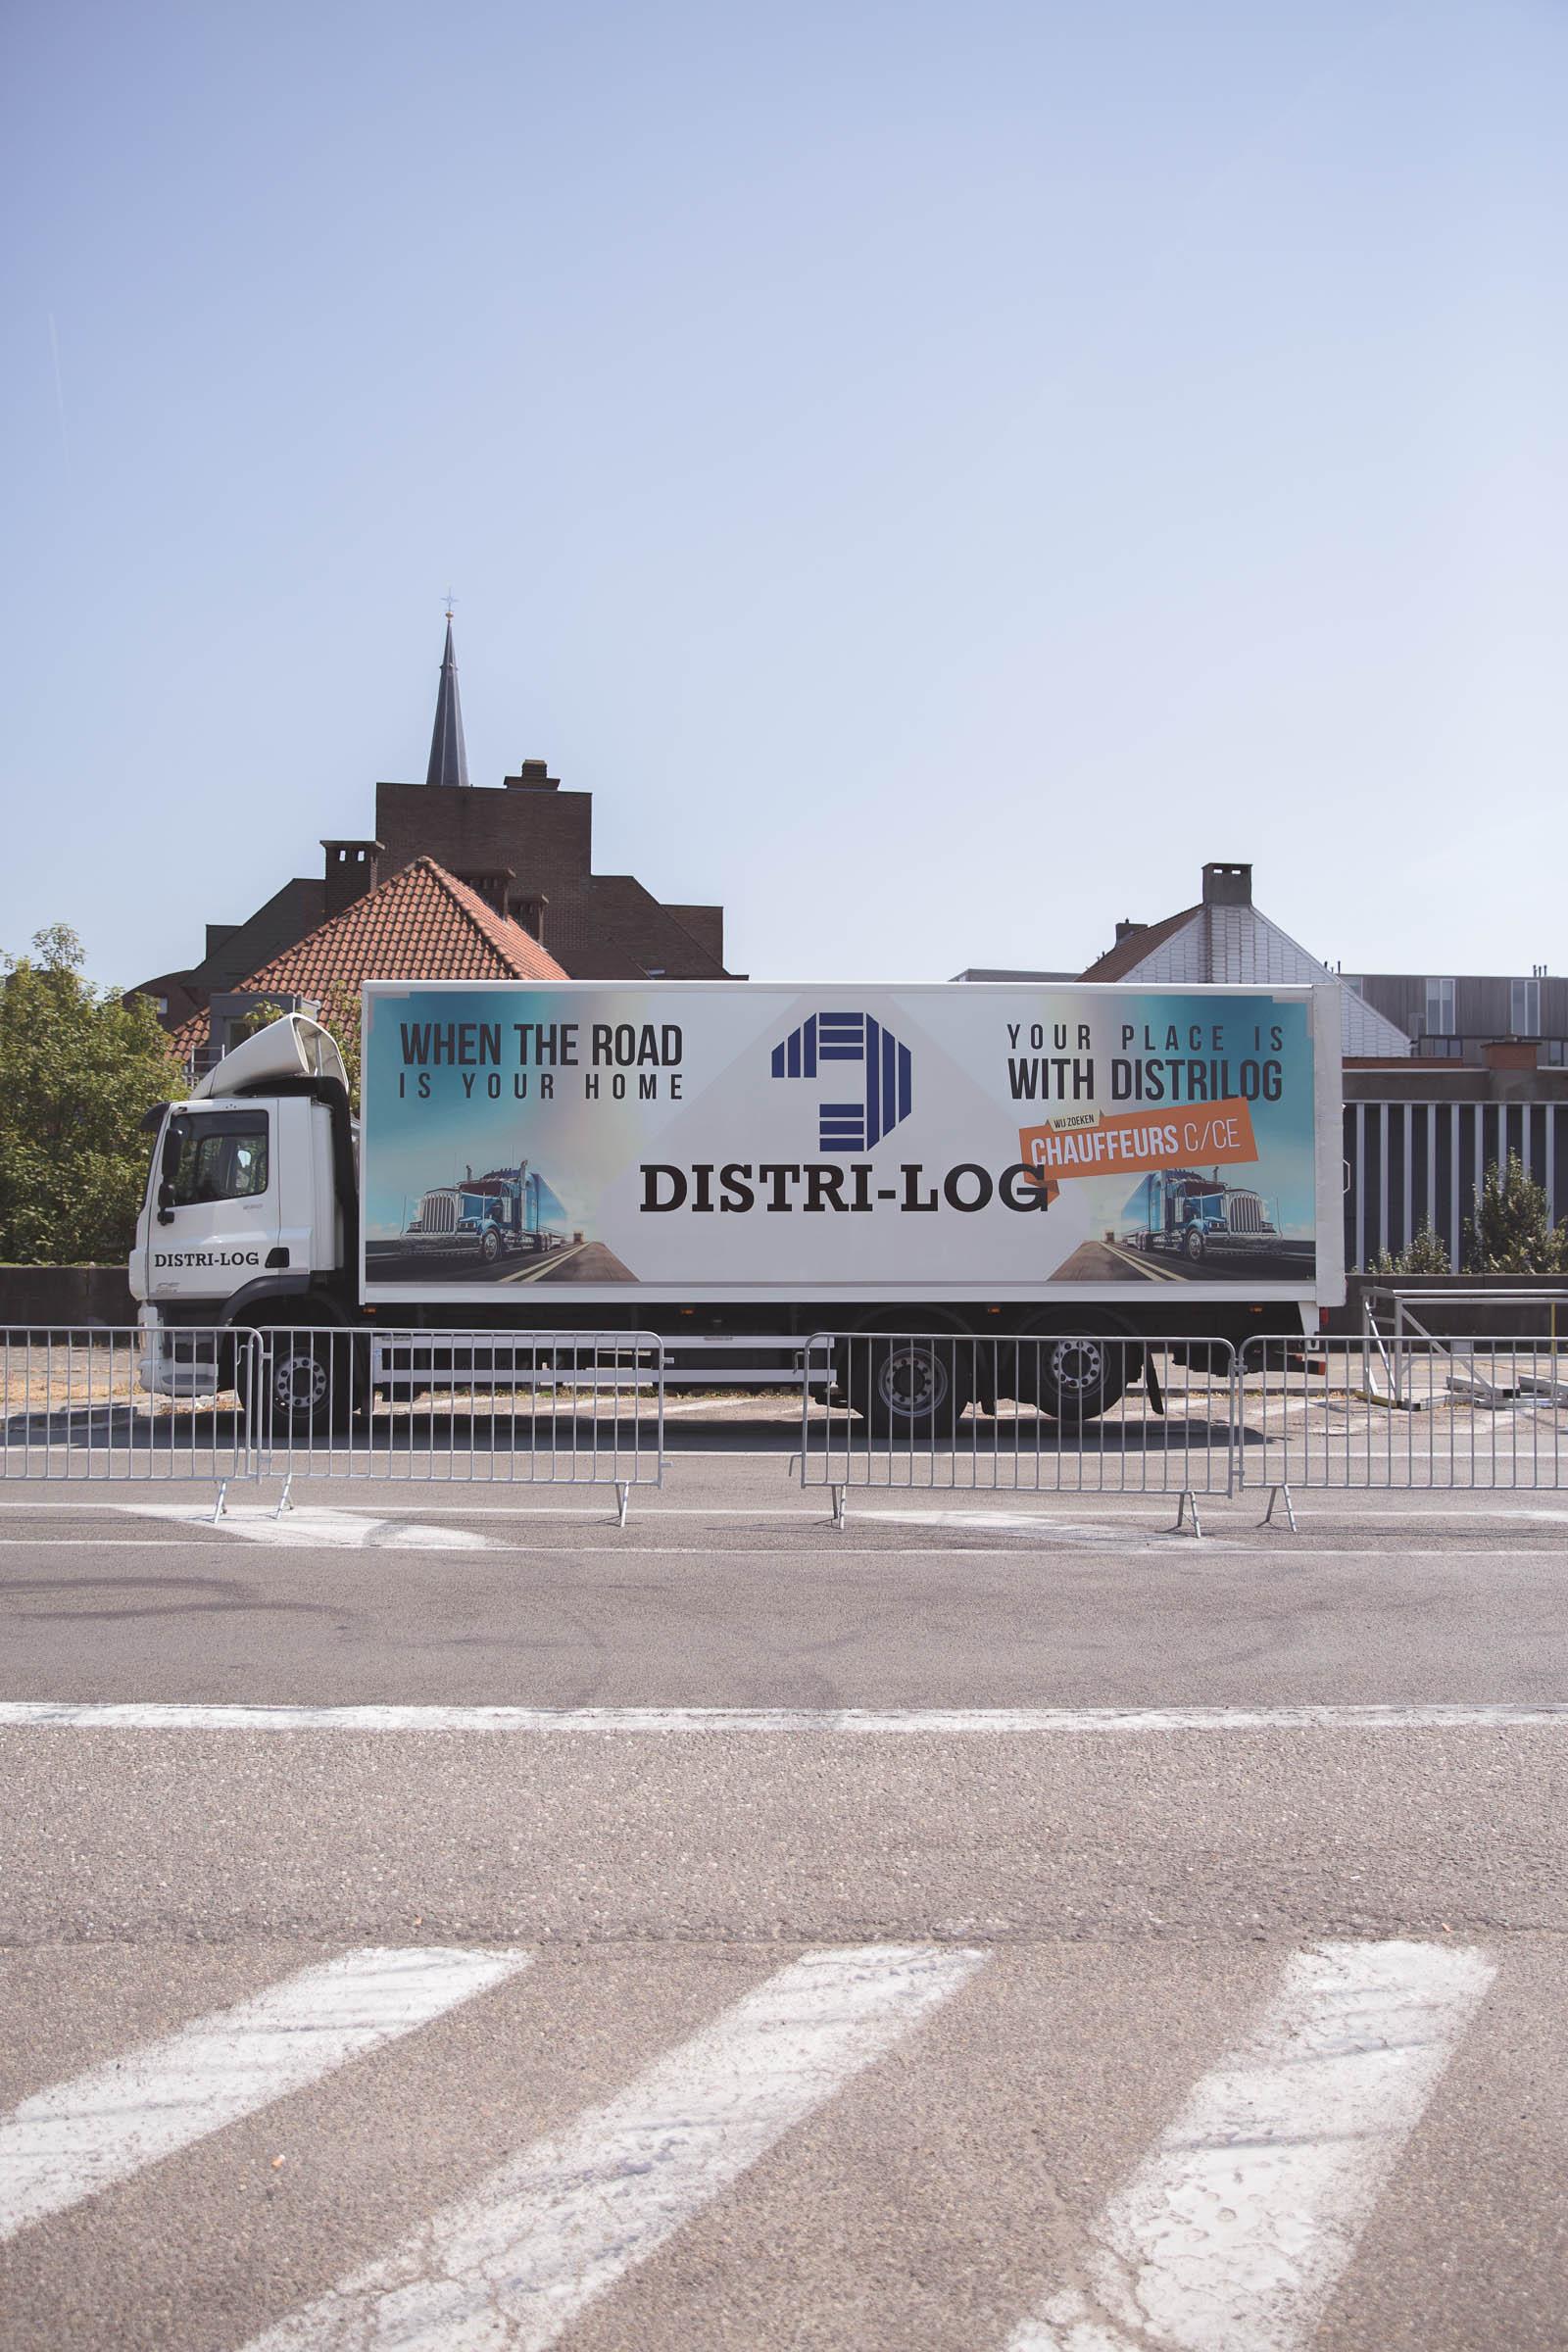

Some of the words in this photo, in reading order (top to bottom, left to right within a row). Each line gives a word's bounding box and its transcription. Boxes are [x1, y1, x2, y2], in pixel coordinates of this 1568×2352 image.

[400, 1023, 502, 1066] WHEN
[514, 1024, 579, 1066] THE
[592, 1024, 683, 1066] ROAD
[1006, 1024, 1091, 1051] YOUR
[1122, 1025, 1224, 1052] PLACE
[1254, 1026, 1283, 1052] IS
[399, 1073, 431, 1099] IS
[462, 1073, 555, 1100] YOUR
[585, 1073, 683, 1100] HOME
[1007, 1058, 1095, 1100] WITH
[1111, 1059, 1282, 1102] DISTRILOG
[1066, 1114, 1095, 1127] ZOEKEN
[1030, 1125, 1179, 1167] CHAUFFEURS
[1184, 1118, 1241, 1152] C/CE
[639, 1163, 1049, 1213] DISTRI-LOG
[155, 1252, 259, 1267] DISTRI-LOG
